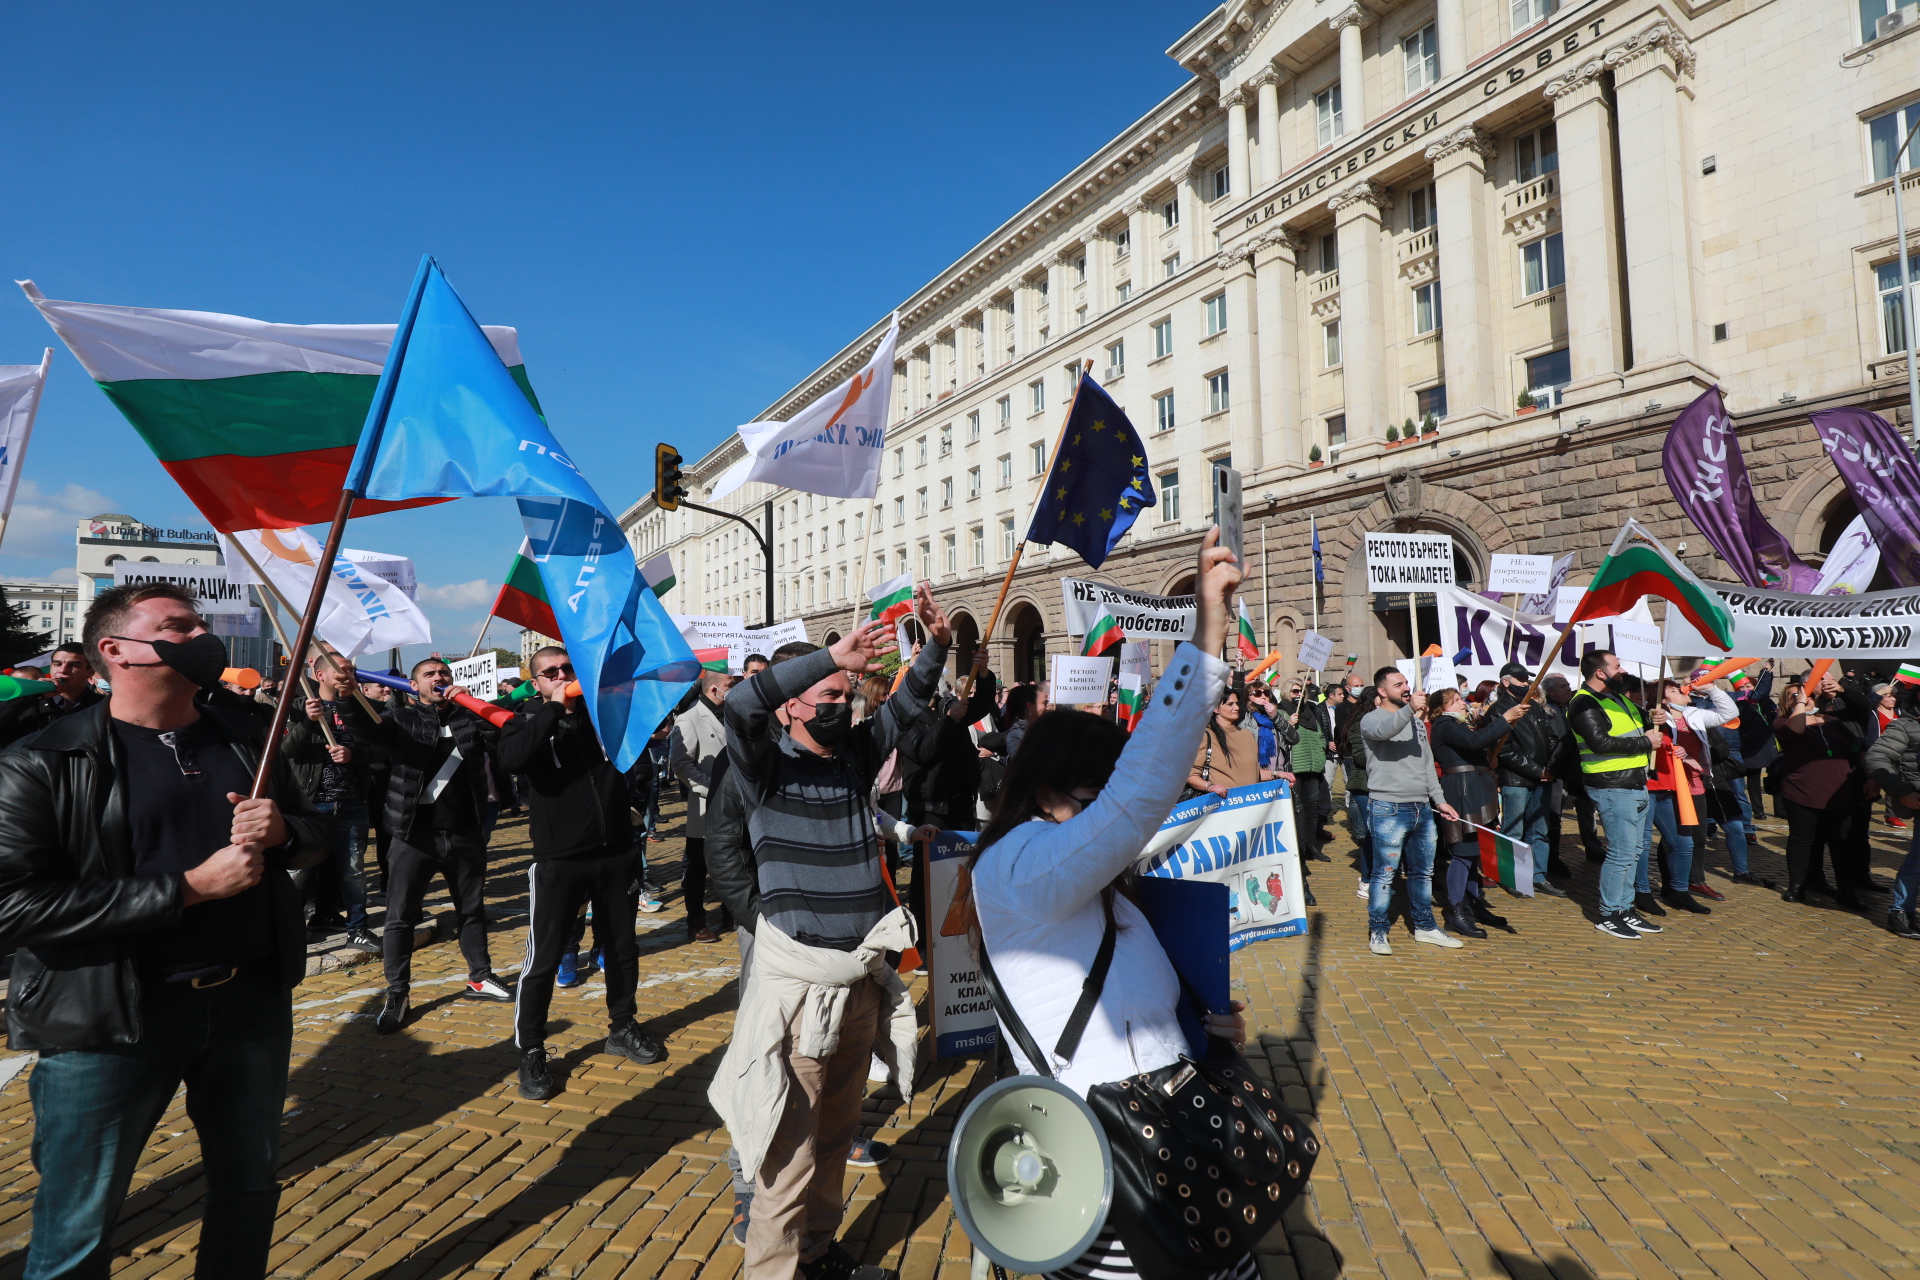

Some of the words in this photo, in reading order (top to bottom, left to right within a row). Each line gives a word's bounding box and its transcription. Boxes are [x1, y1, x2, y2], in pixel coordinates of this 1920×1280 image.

[1245, 111, 1438, 229] МИНИСТЕРСКИ
[1483, 18, 1605, 96] СЪВЕТ
[110, 525, 165, 539] UniCredit
[167, 529, 215, 541] Bulbank
[1368, 540, 1407, 559] РЕСТОТО
[1410, 541, 1451, 563] ВЪРНЕТЕ,
[1510, 558, 1524, 567] НЕ
[1371, 565, 1397, 584] ТОКА
[1399, 566, 1452, 585] НАМАЛЕТЕ!
[1493, 568, 1547, 578] енергийното
[1501, 577, 1537, 586] робство!
[1073, 581, 1097, 602] НЕ
[1100, 590, 1121, 605] на
[1115, 612, 1185, 633] робство!
[1771, 625, 1788, 648] И
[1794, 625, 1912, 649] СИСТЕМИ
[1227, 796, 1244, 807] 359
[1245, 792, 1261, 803] 431
[955, 1031, 997, 1049] msh@
